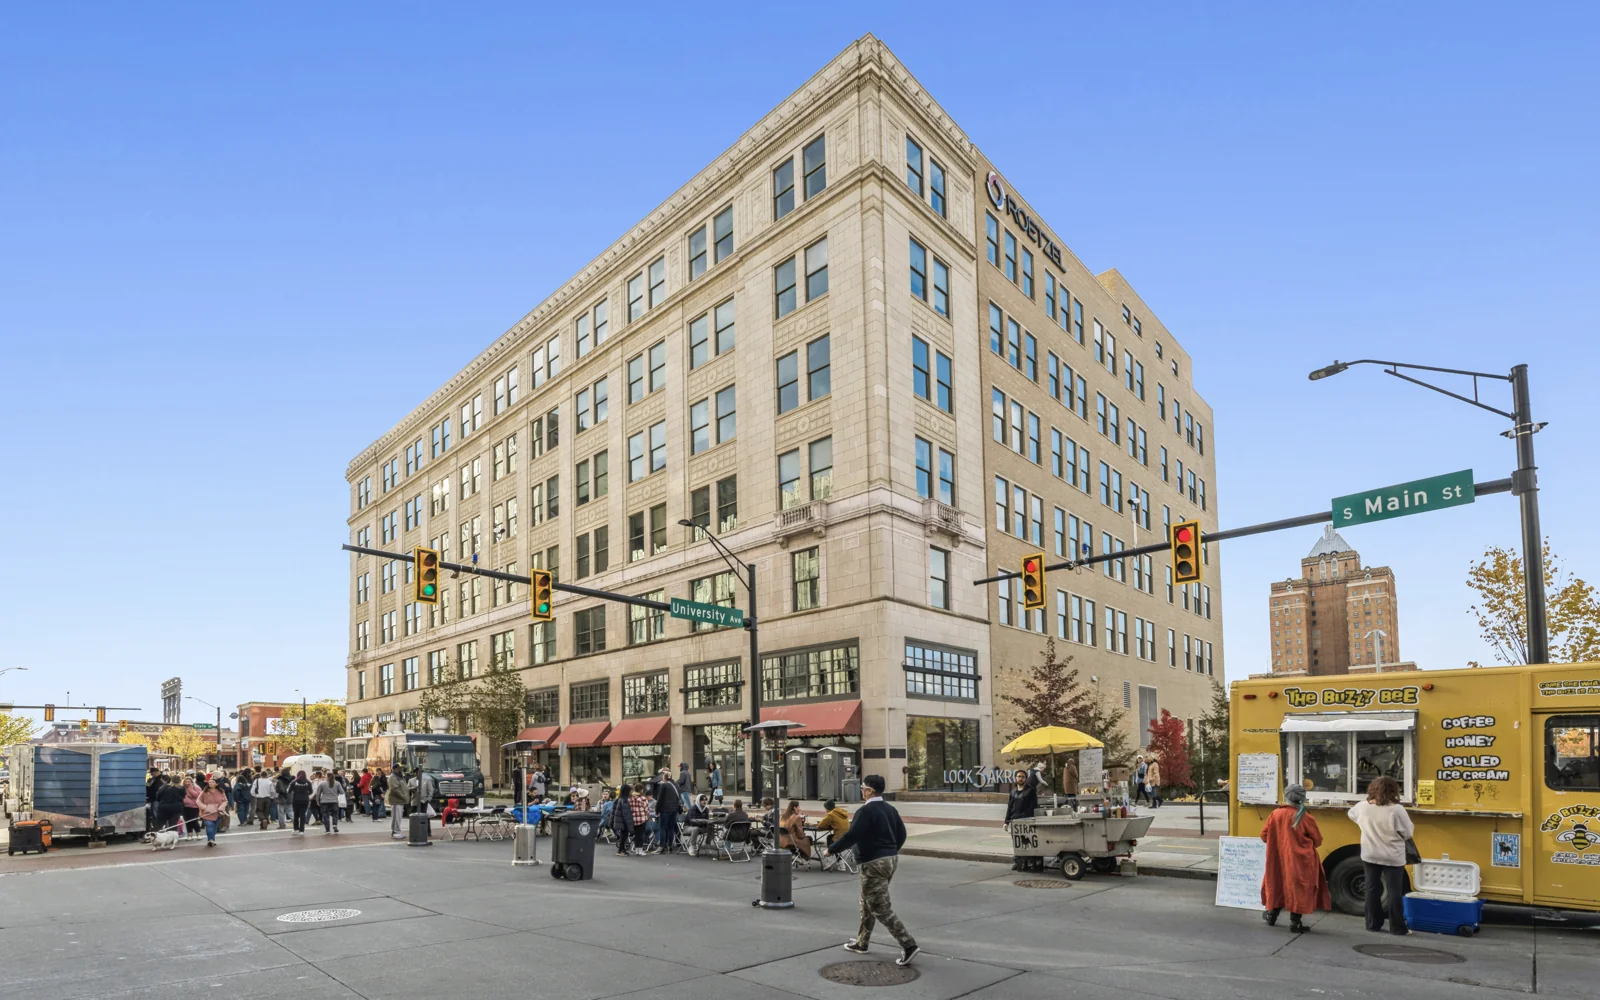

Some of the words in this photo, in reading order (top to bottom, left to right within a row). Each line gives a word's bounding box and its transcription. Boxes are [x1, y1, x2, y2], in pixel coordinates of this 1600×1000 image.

[1006, 194, 1066, 273] ROETZEL
[1343, 507, 1353, 520] S
[1365, 490, 1428, 515] Main
[1442, 485, 1462, 500] St
[672, 602, 726, 623] University
[729, 615, 741, 624] Ave
[1446, 735, 1496, 748] HONEY
[1442, 755, 1501, 768] ROLLED
[944, 770, 973, 783] LOCK
[973, 765, 989, 788] 3
[1014, 835, 1038, 848] DG
